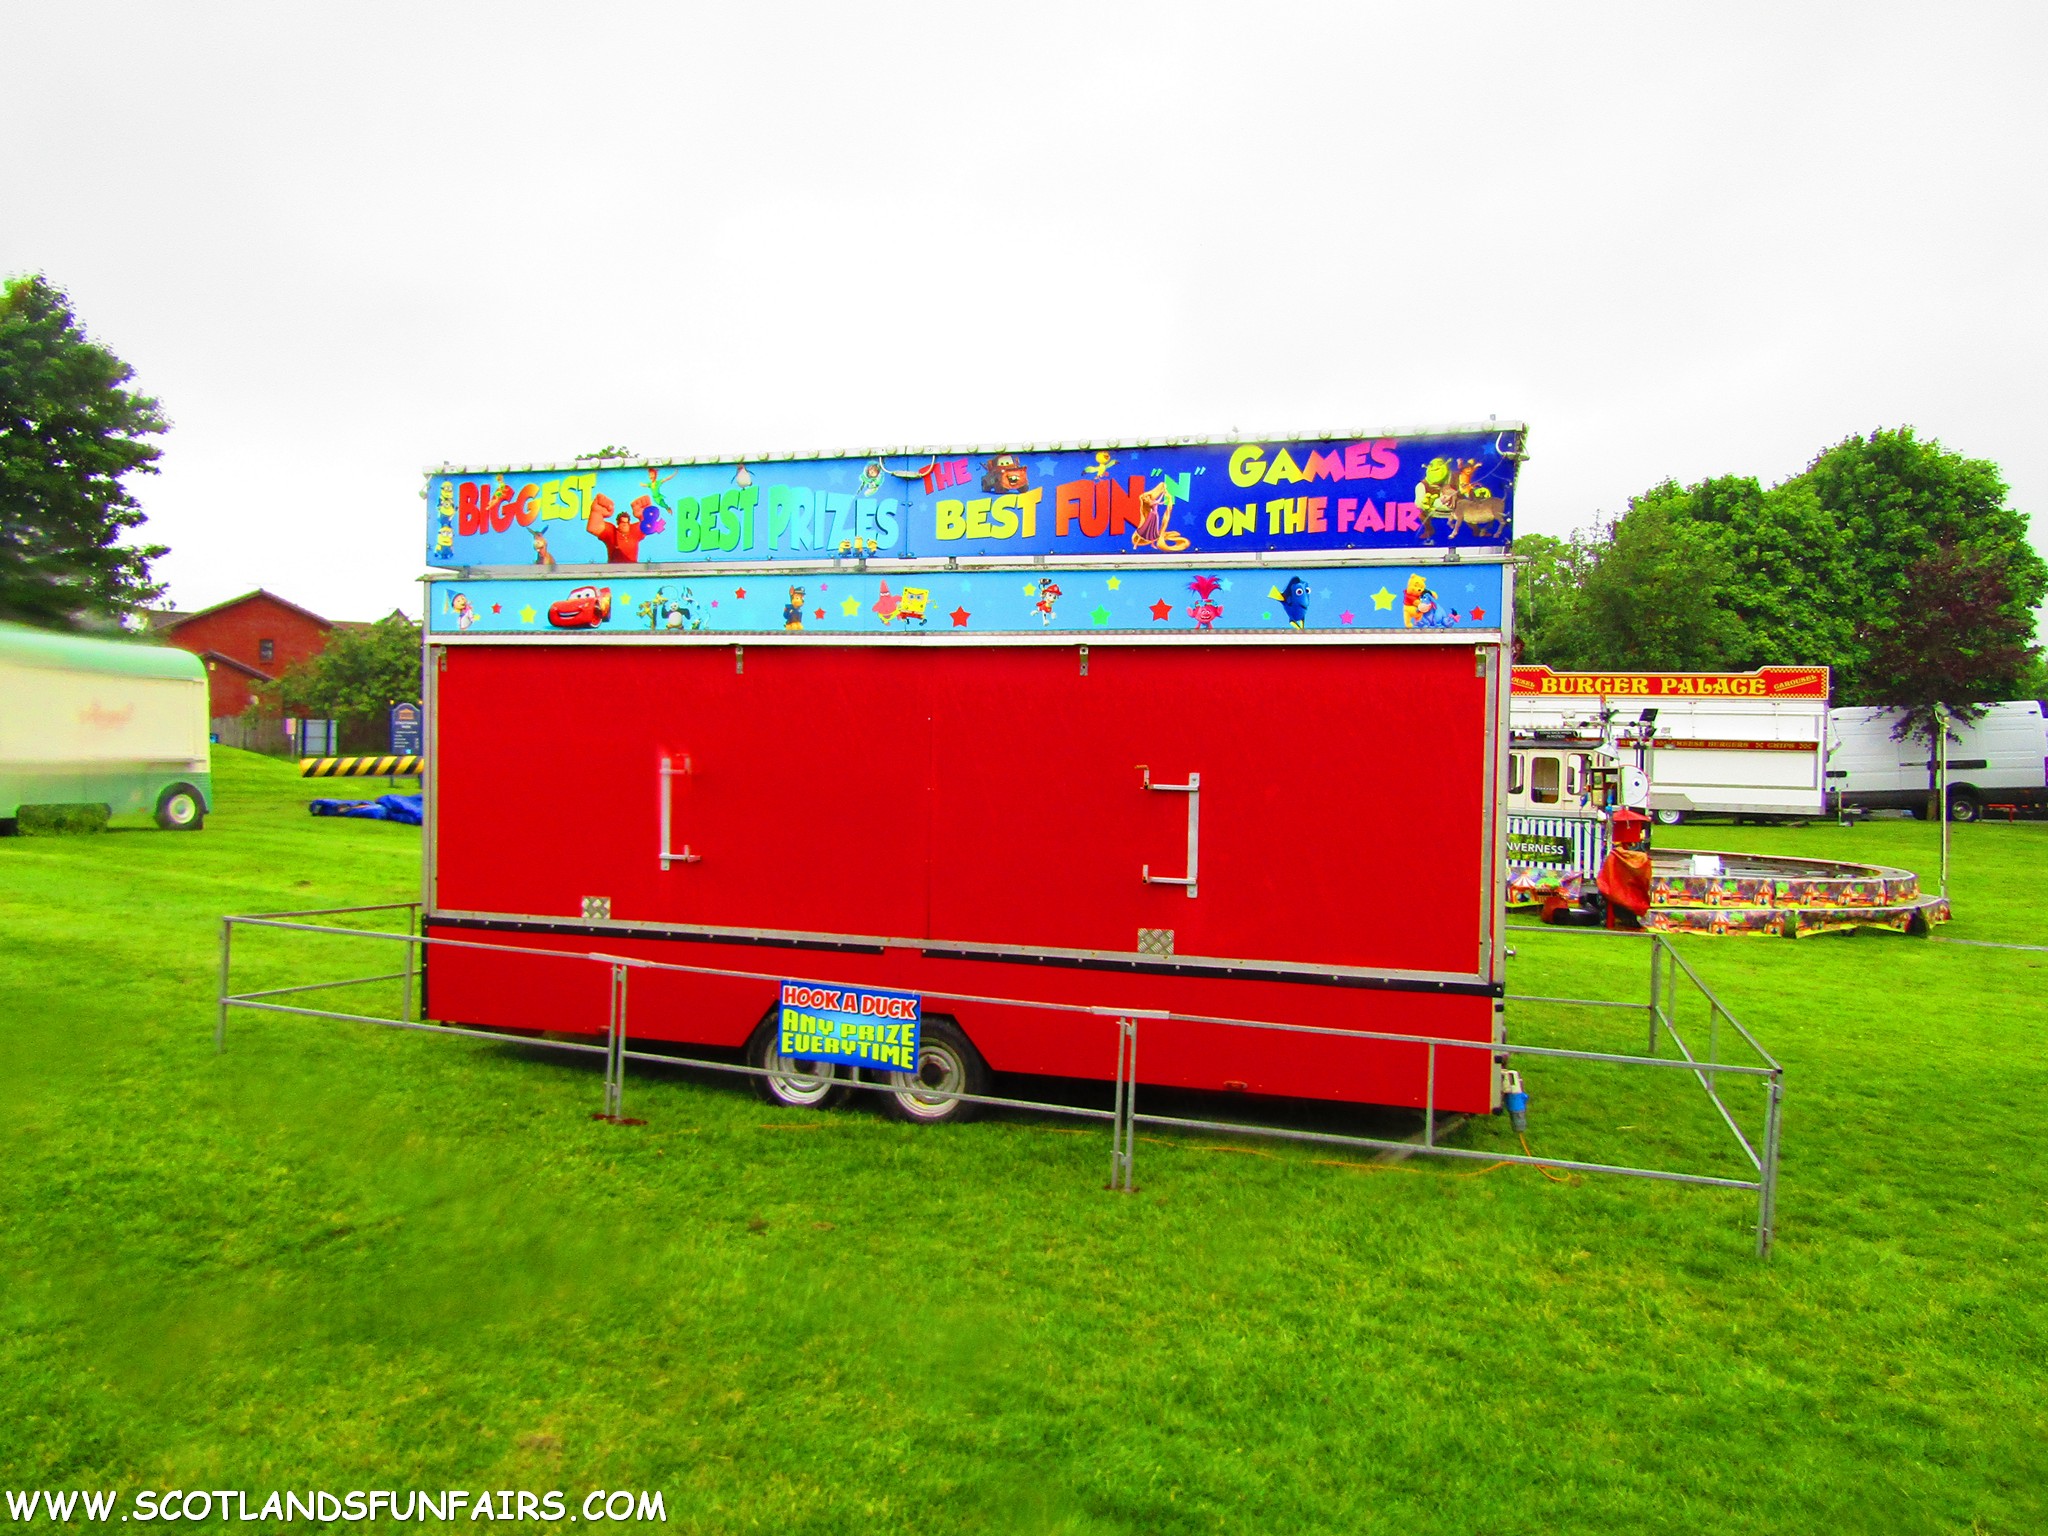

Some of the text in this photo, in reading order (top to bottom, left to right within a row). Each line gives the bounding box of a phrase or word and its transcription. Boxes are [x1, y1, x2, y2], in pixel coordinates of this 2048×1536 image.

[919, 459, 972, 494] THE
[1228, 438, 1400, 488] GAMES
[459, 473, 899, 552] BIGGEST & BEST PRIZES
[936, 487, 1043, 540] BEST
[1055, 476, 1146, 537] FUN
[1206, 496, 1422, 537] ON THE FAIR
[1541, 677, 1766, 695] BURGER PALACE
[1506, 842, 1564, 854] NVERNESS
[783, 985, 916, 1020] HOOK A DUCK
[783, 1008, 915, 1046] ANY PRIZE
[782, 1032, 914, 1070] EVERYTIME
